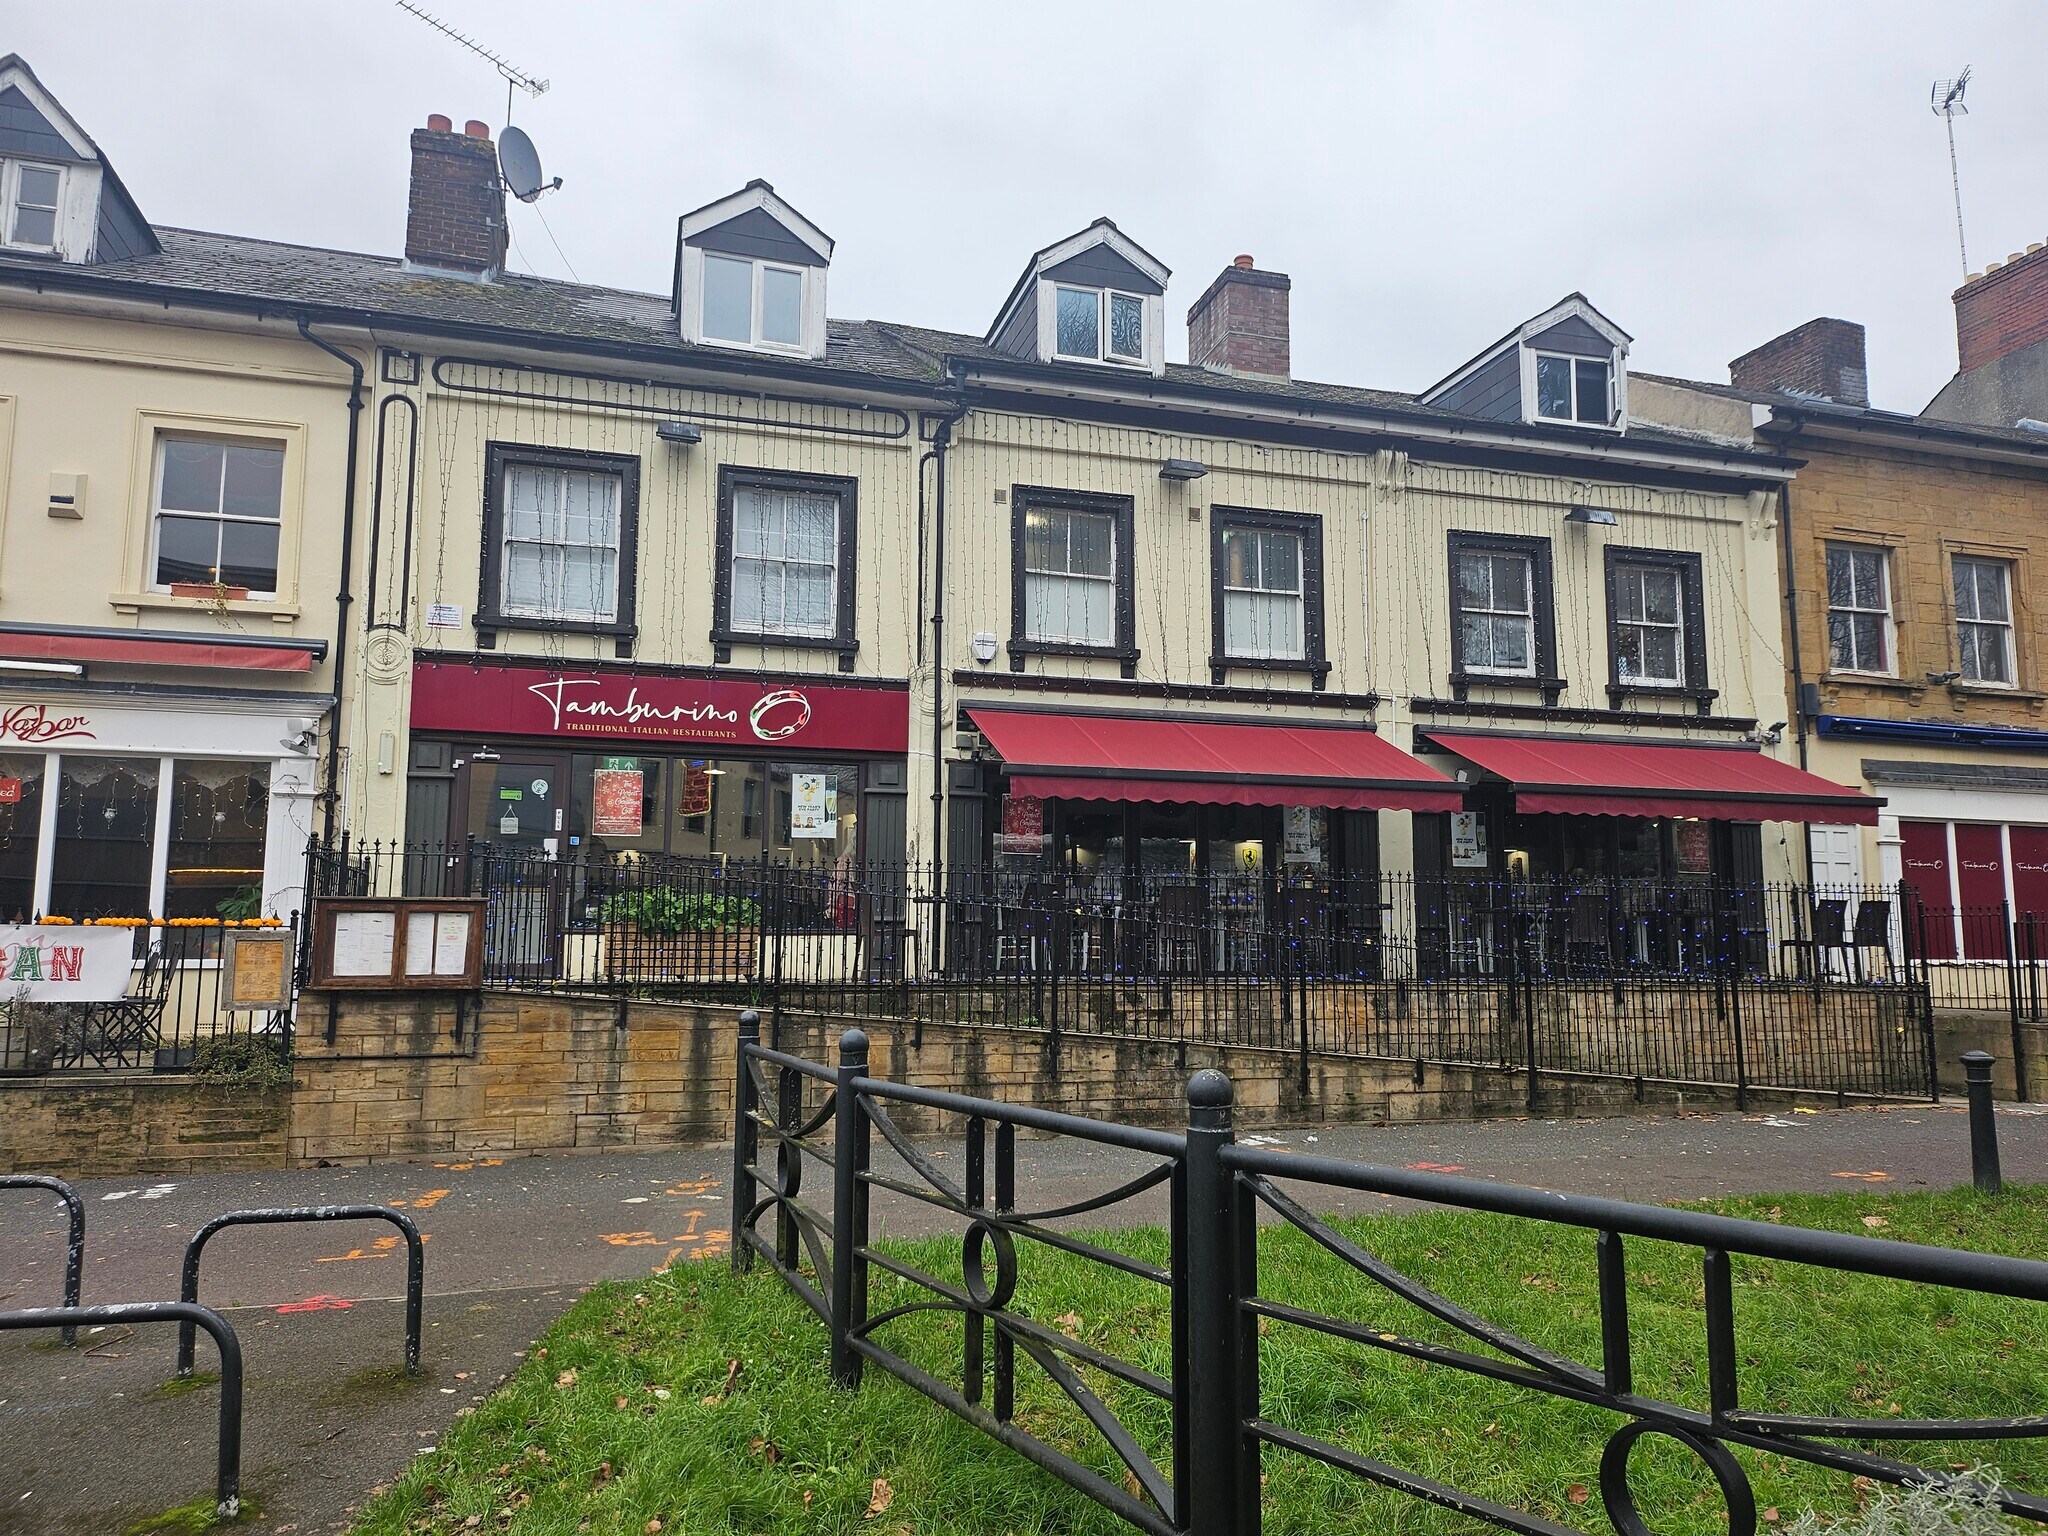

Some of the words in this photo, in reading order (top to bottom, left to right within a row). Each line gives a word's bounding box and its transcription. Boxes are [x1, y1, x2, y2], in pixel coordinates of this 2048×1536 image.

[528, 677, 738, 730] Tamburino
[0, 704, 97, 743] Kazbar
[566, 722, 630, 734] TRADITIONAL
[632, 726, 670, 736] ITALIAN
[672, 728, 738, 739] RESTAURANTS
